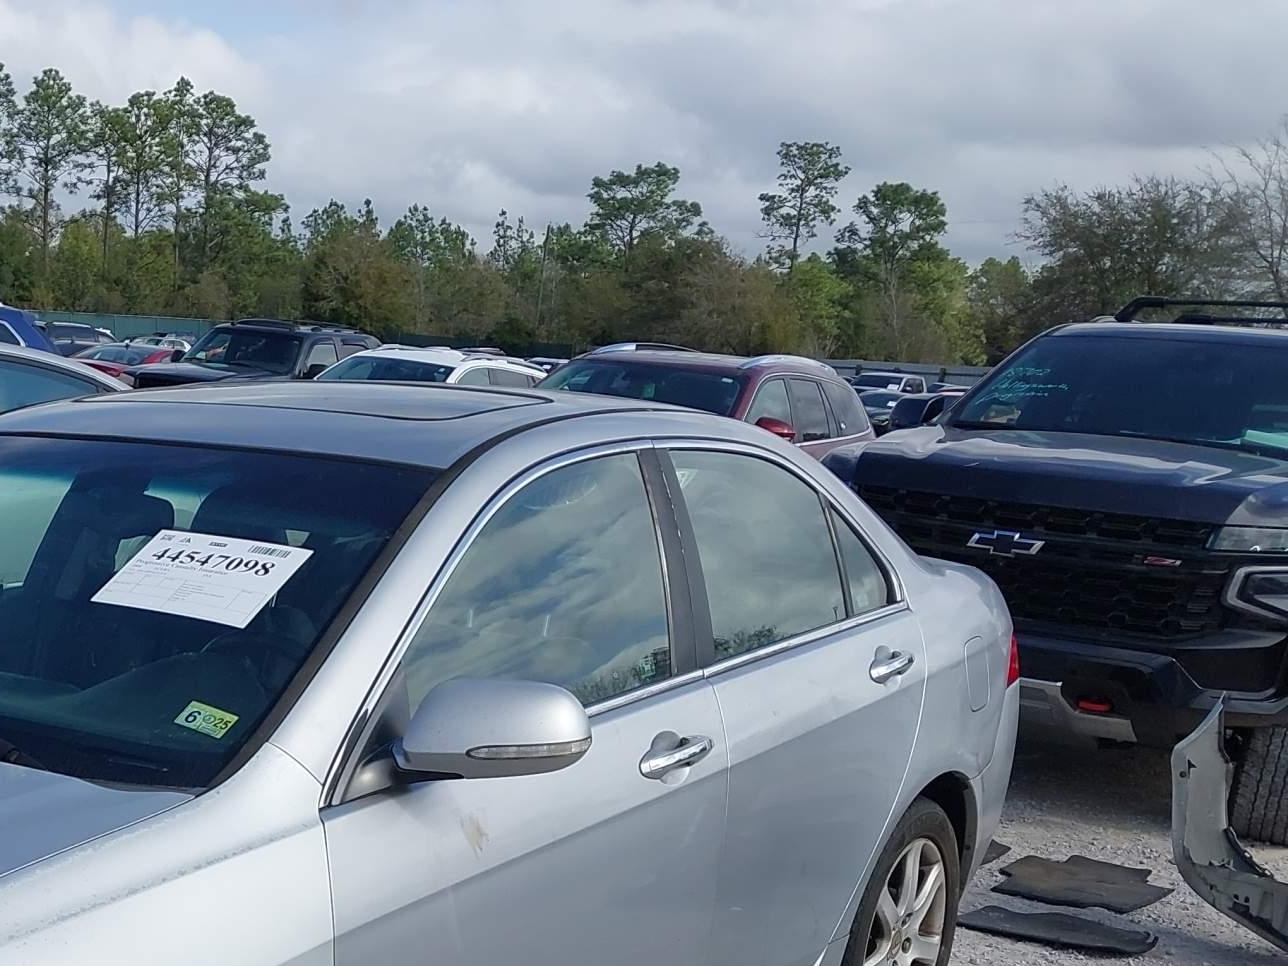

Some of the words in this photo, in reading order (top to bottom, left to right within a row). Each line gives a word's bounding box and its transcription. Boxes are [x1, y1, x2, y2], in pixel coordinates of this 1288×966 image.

[152, 548, 276, 577] 44547098
[185, 711, 201, 723] 6
[213, 718, 232, 730] 25
